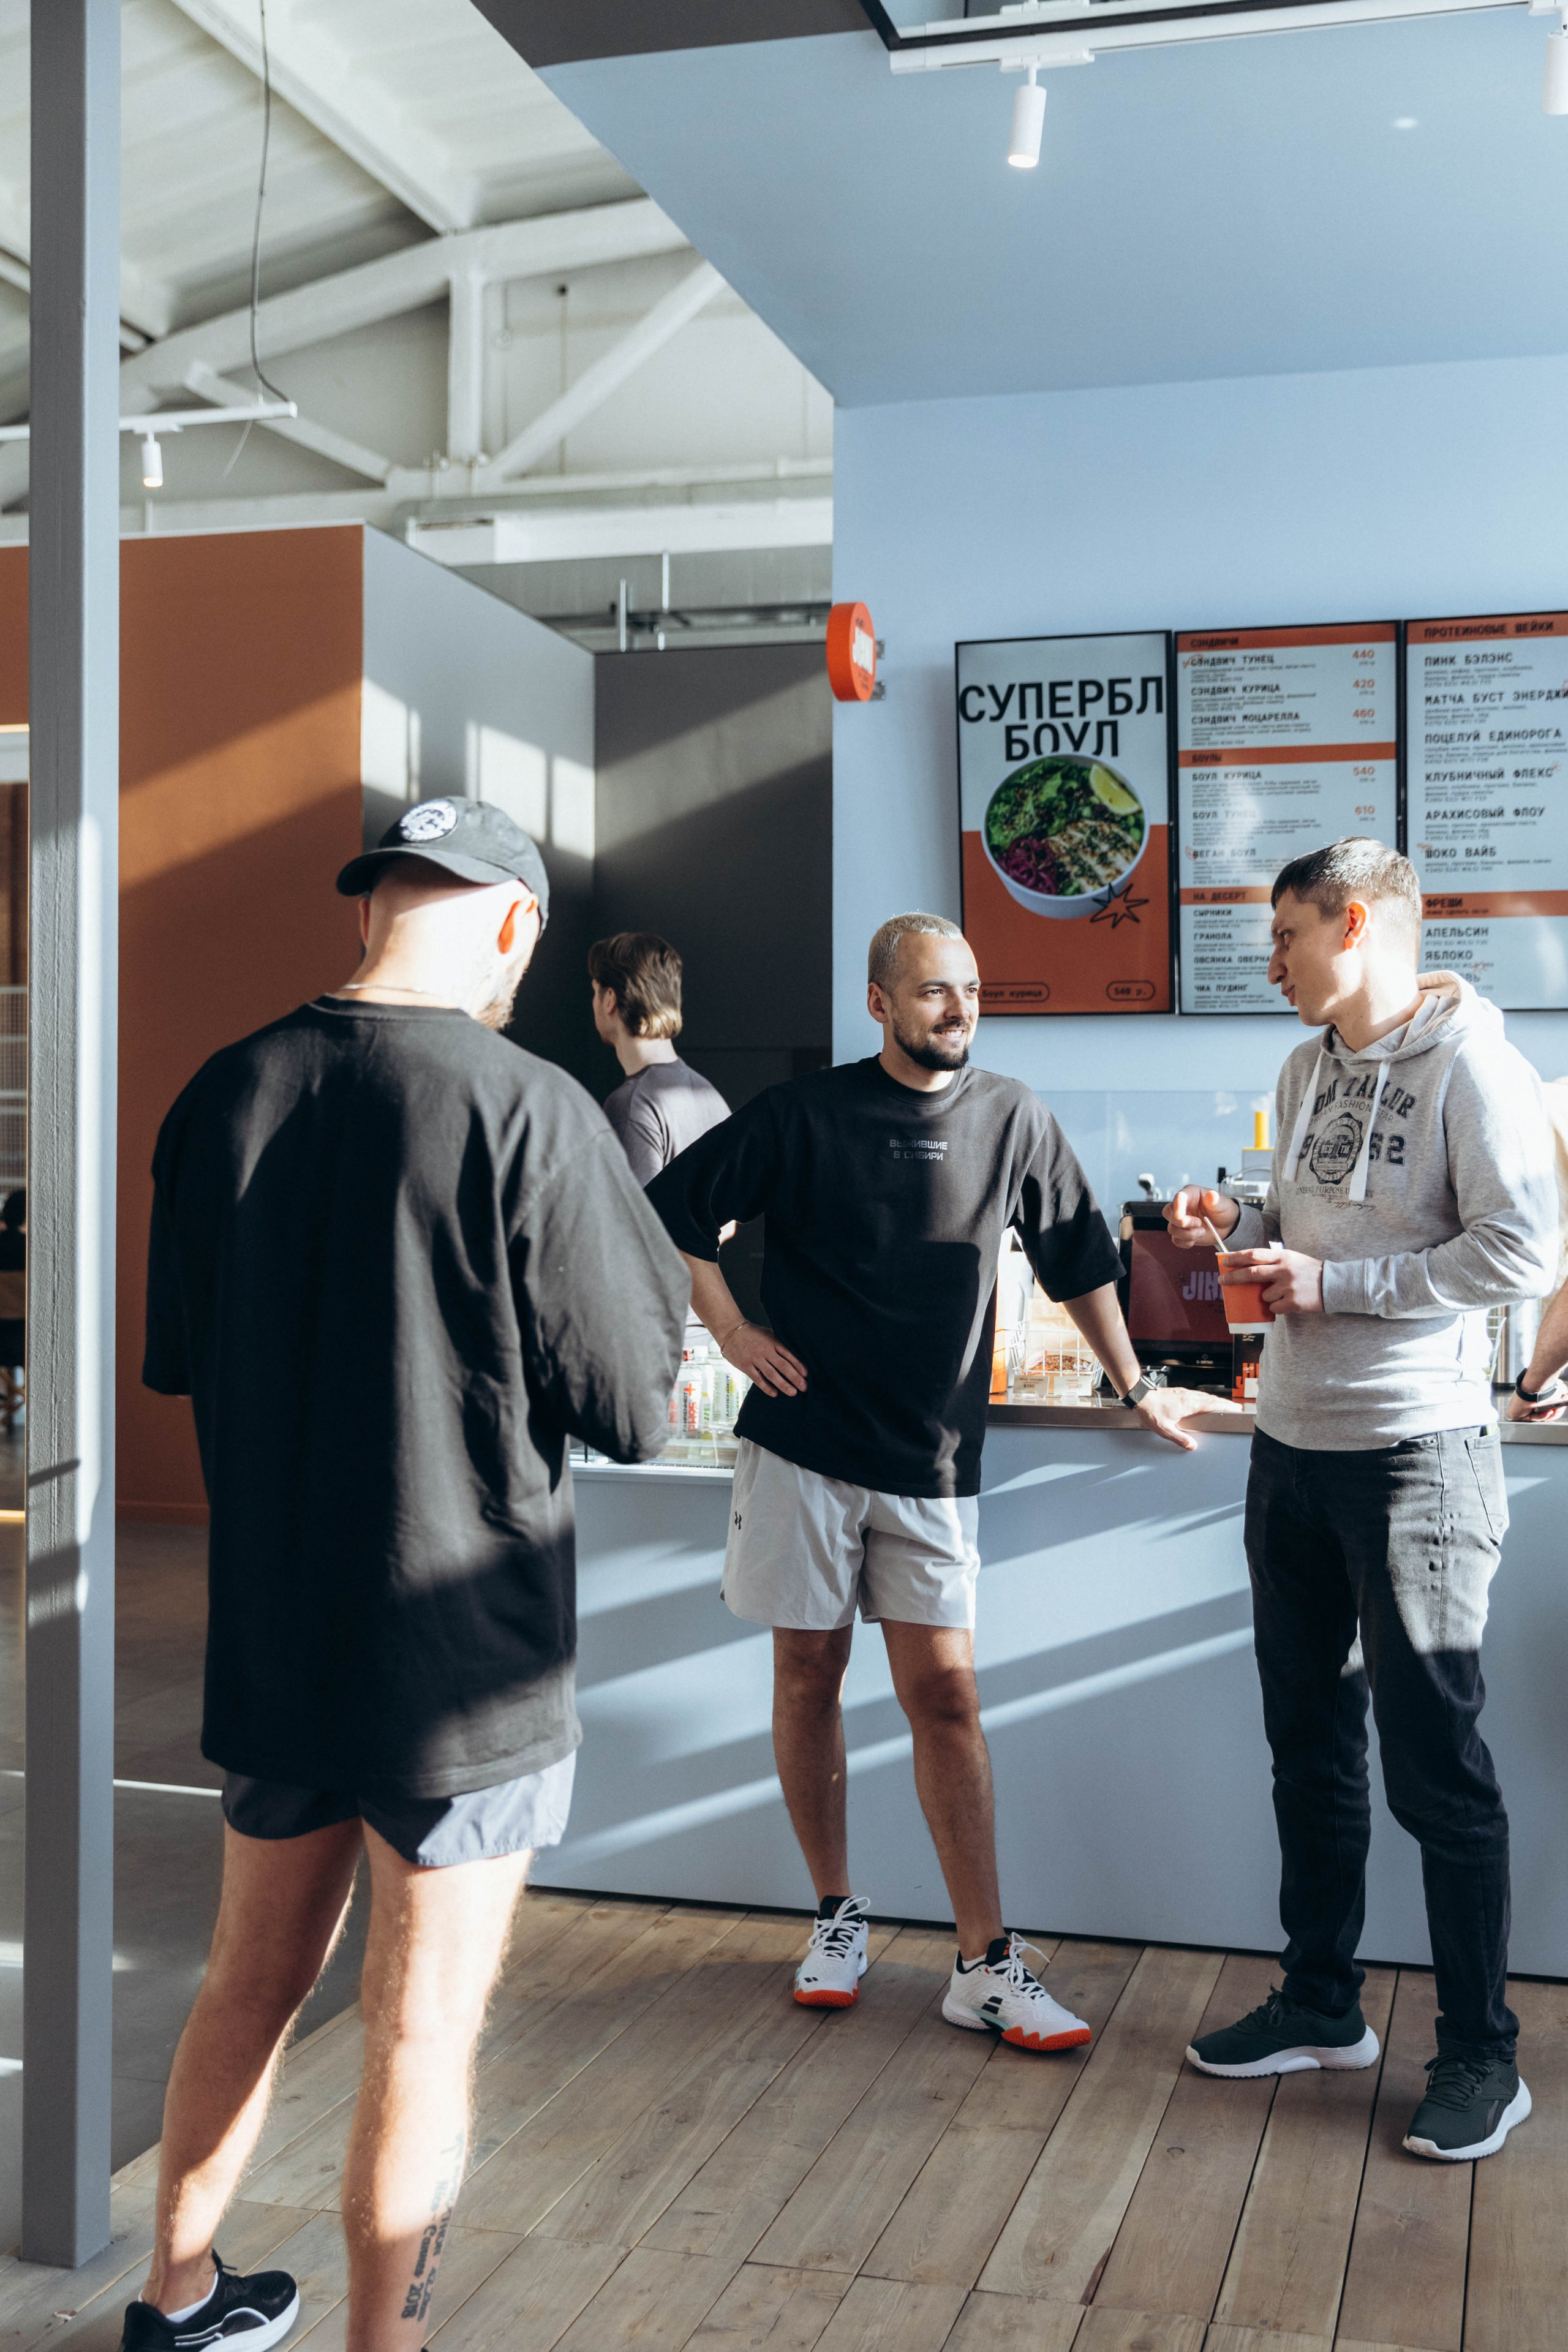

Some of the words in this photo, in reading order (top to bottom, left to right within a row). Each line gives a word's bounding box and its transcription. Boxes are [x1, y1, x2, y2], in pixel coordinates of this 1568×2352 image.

[1424, 624, 1507, 638] ПРОТЕИНОВЫЕ
[1515, 620, 1554, 633] ШЕЙКИ
[1352, 649, 1375, 659] 440
[1425, 655, 1456, 667] ПИНК
[1464, 652, 1513, 665] БЭЛЭНС
[1191, 656, 1236, 666] СЭНДВИЧ
[1242, 654, 1274, 664] ТУНЕЦ
[1353, 679, 1375, 688] 420
[1191, 685, 1236, 696] СЭНДВИЧ
[1242, 684, 1281, 694] КУРИЦА
[959, 676, 1163, 723] СУПЕРБЛ
[1425, 694, 1464, 706] МАТЧА
[1473, 692, 1505, 704] БУСТ
[1191, 715, 1236, 725] СЭНДВИЧ
[1242, 712, 1300, 723] МОЦАРЕЛЛА
[1005, 720, 1119, 761] БОУЛ
[1425, 730, 1480, 745] ПОЦЕЛУЙ
[1489, 728, 1561, 742] ЕДИНОРОГА
[1192, 772, 1218, 782] БОУЛ
[1224, 771, 1262, 780] КУРИЦА
[1353, 766, 1375, 776] 540
[1425, 767, 1504, 782] КЛУБНИЧНЫЙ
[1513, 767, 1553, 778] ФЛЕКС
[1193, 810, 1218, 820] БОУЛ
[1355, 805, 1375, 815] 610
[1425, 805, 1504, 821] АРАХИСОВЫЙ
[1513, 806, 1545, 817] ФЛОУ
[1193, 849, 1224, 859] ВЕГАН
[1231, 848, 1256, 857] БОУЛ
[1425, 848, 1457, 859] ШОКО
[1465, 845, 1496, 858] ВАЙБ
[1194, 892, 1205, 900] НА
[1211, 891, 1246, 902] ДЕСЕРТ
[1425, 898, 1463, 908] ФРЕШИ
[1425, 927, 1489, 938] АПЕЛЬСИН
[1425, 950, 1473, 961] ЯБЛОКО
[1216, 984, 1248, 993] ПУДИНГ
[1300, 1079, 1339, 1116] OM
[1343, 1074, 1417, 1119] TAILOR
[1334, 1100, 1372, 1114] FASHION
[889, 1139, 948, 1150] ВЫЖИВШИЕ
[893, 1150, 900, 1159] В
[904, 1150, 943, 1161] СИБИРИ
[1316, 1185, 1343, 1195] PURPOSE
[1183, 1271, 1224, 1300] JIN
